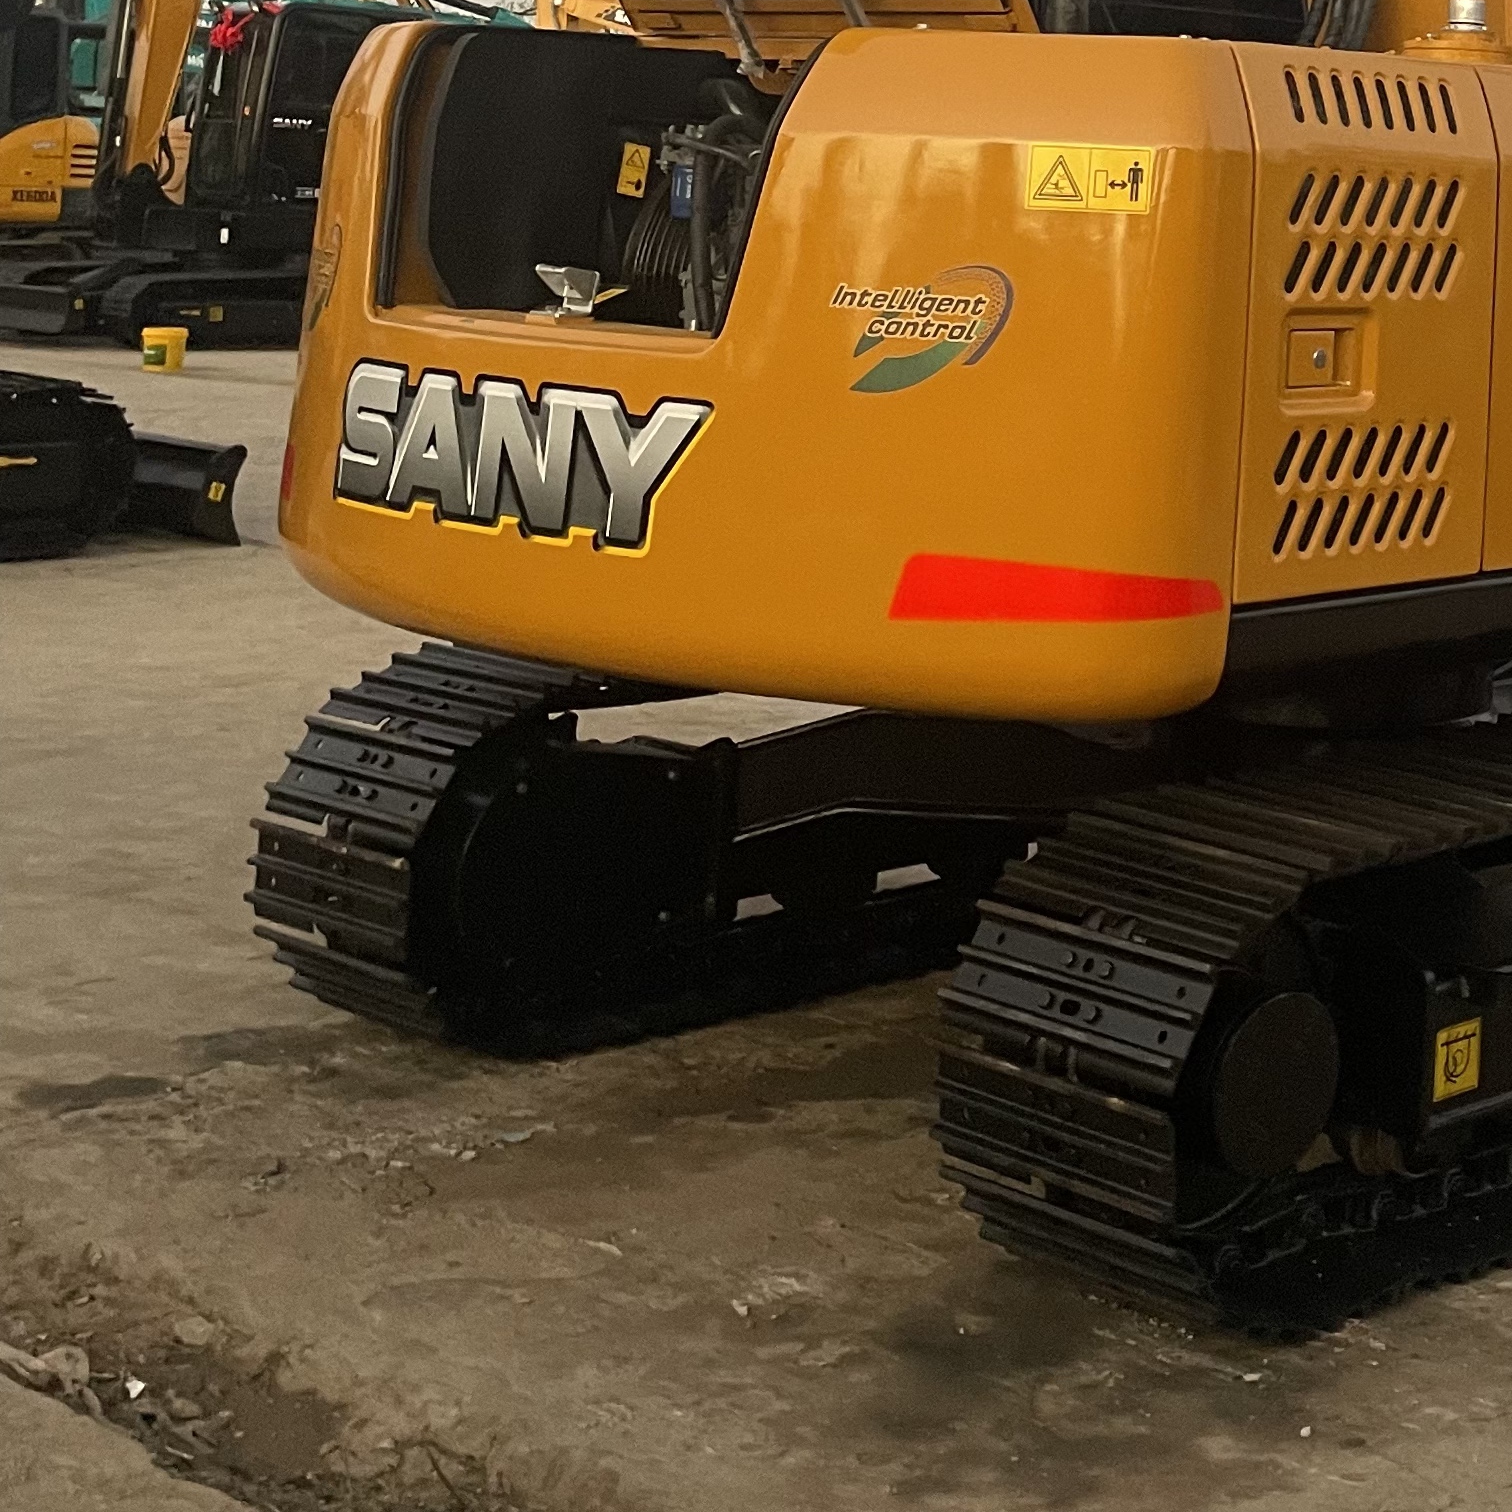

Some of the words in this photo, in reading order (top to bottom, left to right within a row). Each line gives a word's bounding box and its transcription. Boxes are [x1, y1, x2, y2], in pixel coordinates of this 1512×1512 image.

[831, 284, 988, 319] Intelligent
[866, 318, 980, 342] control
[336, 360, 713, 546] SANY
